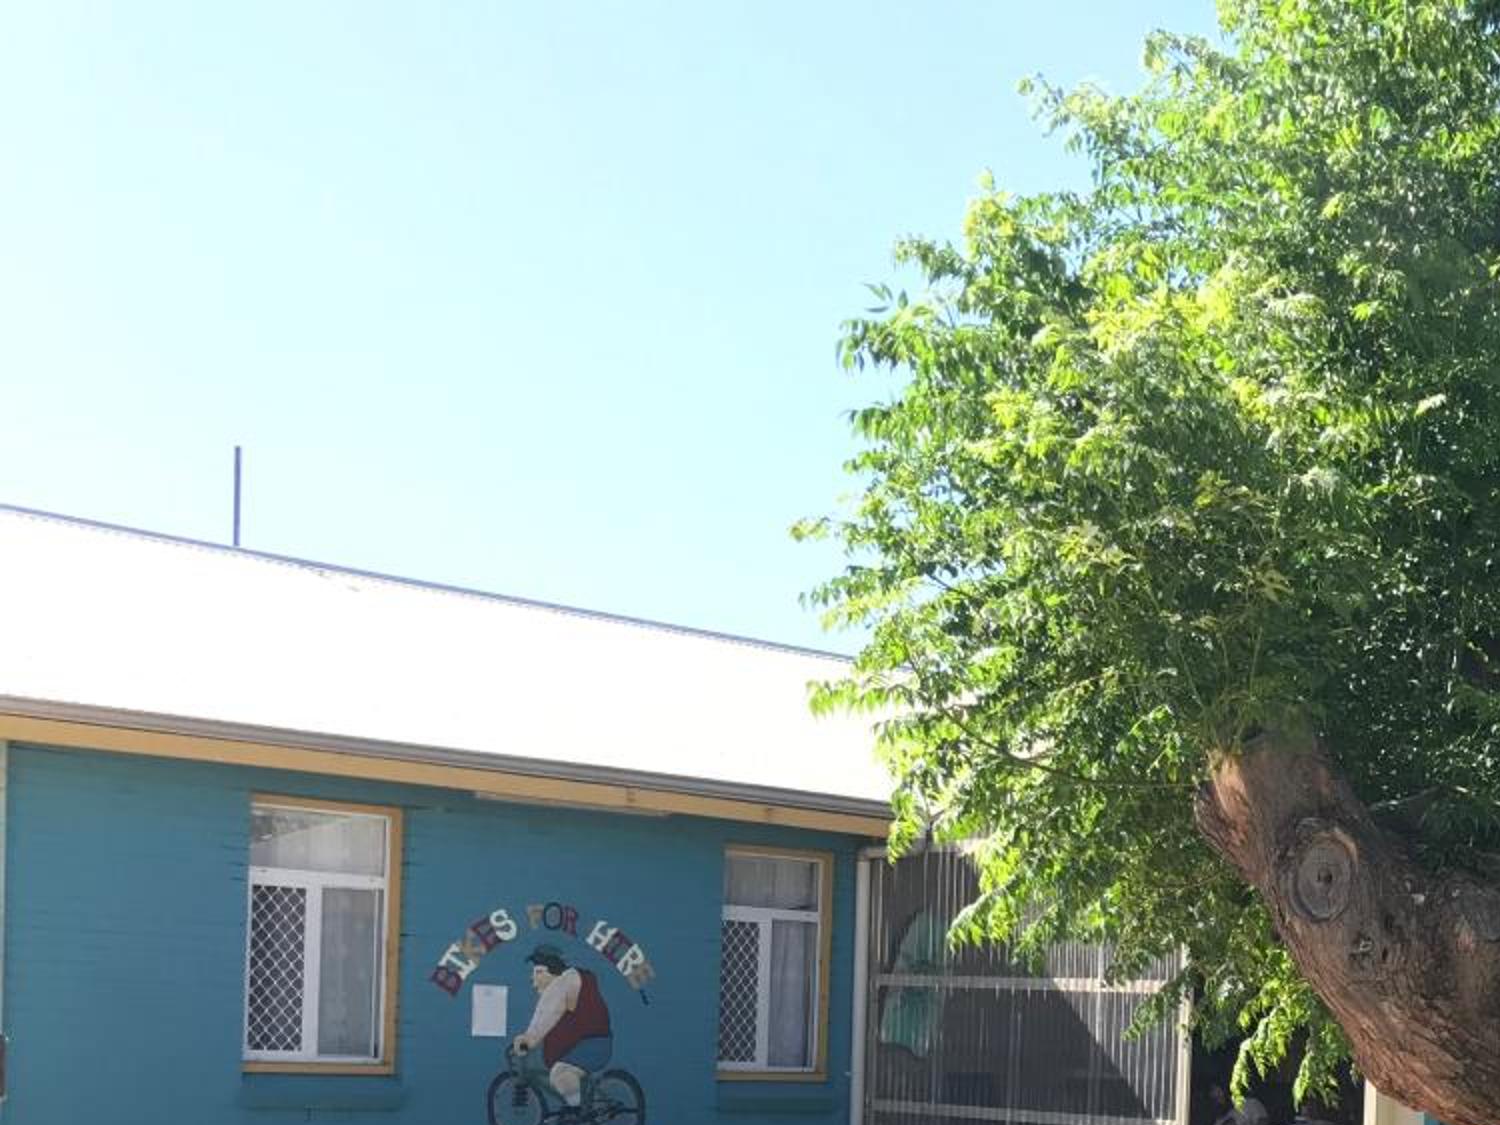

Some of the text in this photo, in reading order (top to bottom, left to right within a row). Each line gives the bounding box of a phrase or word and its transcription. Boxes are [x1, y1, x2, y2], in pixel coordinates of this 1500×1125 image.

[431, 902, 655, 995] BIKES FOR HIRE
